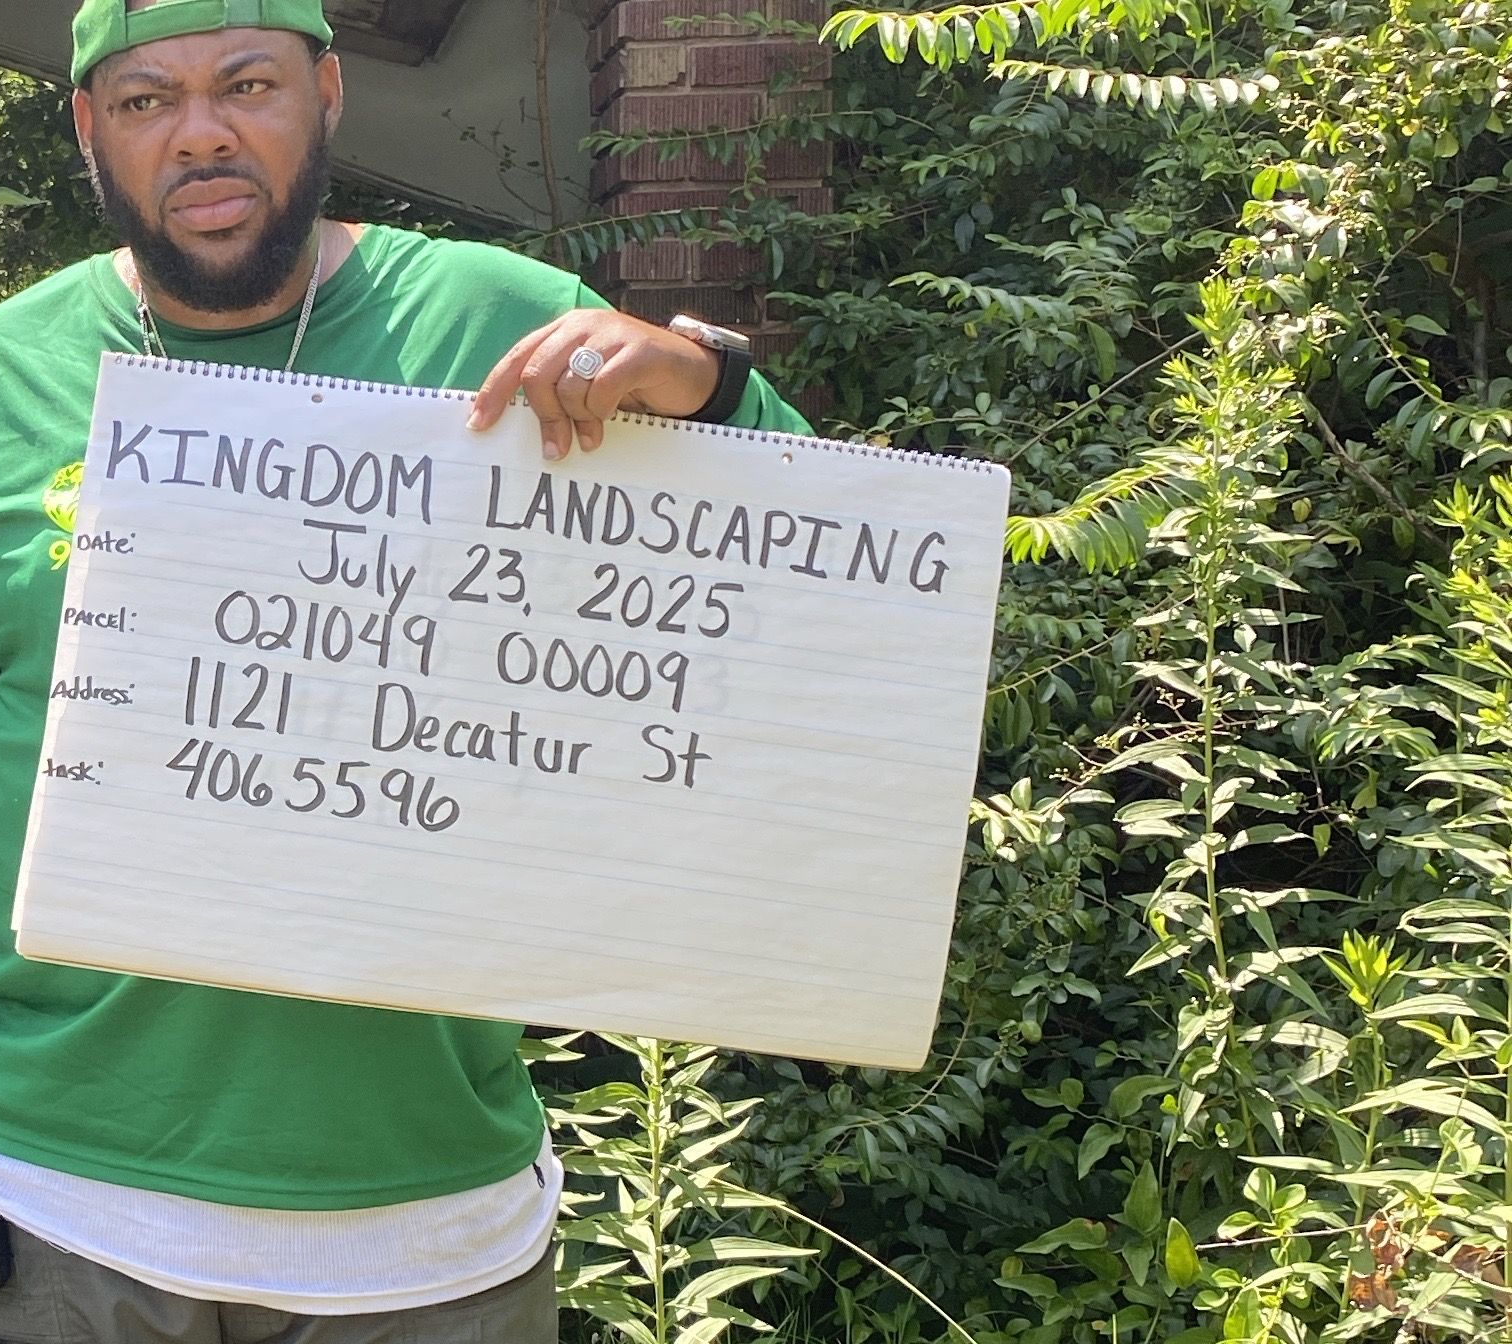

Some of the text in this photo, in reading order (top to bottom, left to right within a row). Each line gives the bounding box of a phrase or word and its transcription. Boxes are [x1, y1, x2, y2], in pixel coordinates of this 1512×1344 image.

[105, 419, 952, 595] KINGDOM LANDSCAPING
[296, 517, 746, 640] July 23, 2025
[213, 589, 691, 715] 021049 00009
[164, 736, 462, 834] 4065596
[184, 655, 714, 790] 1121 Decatur St
